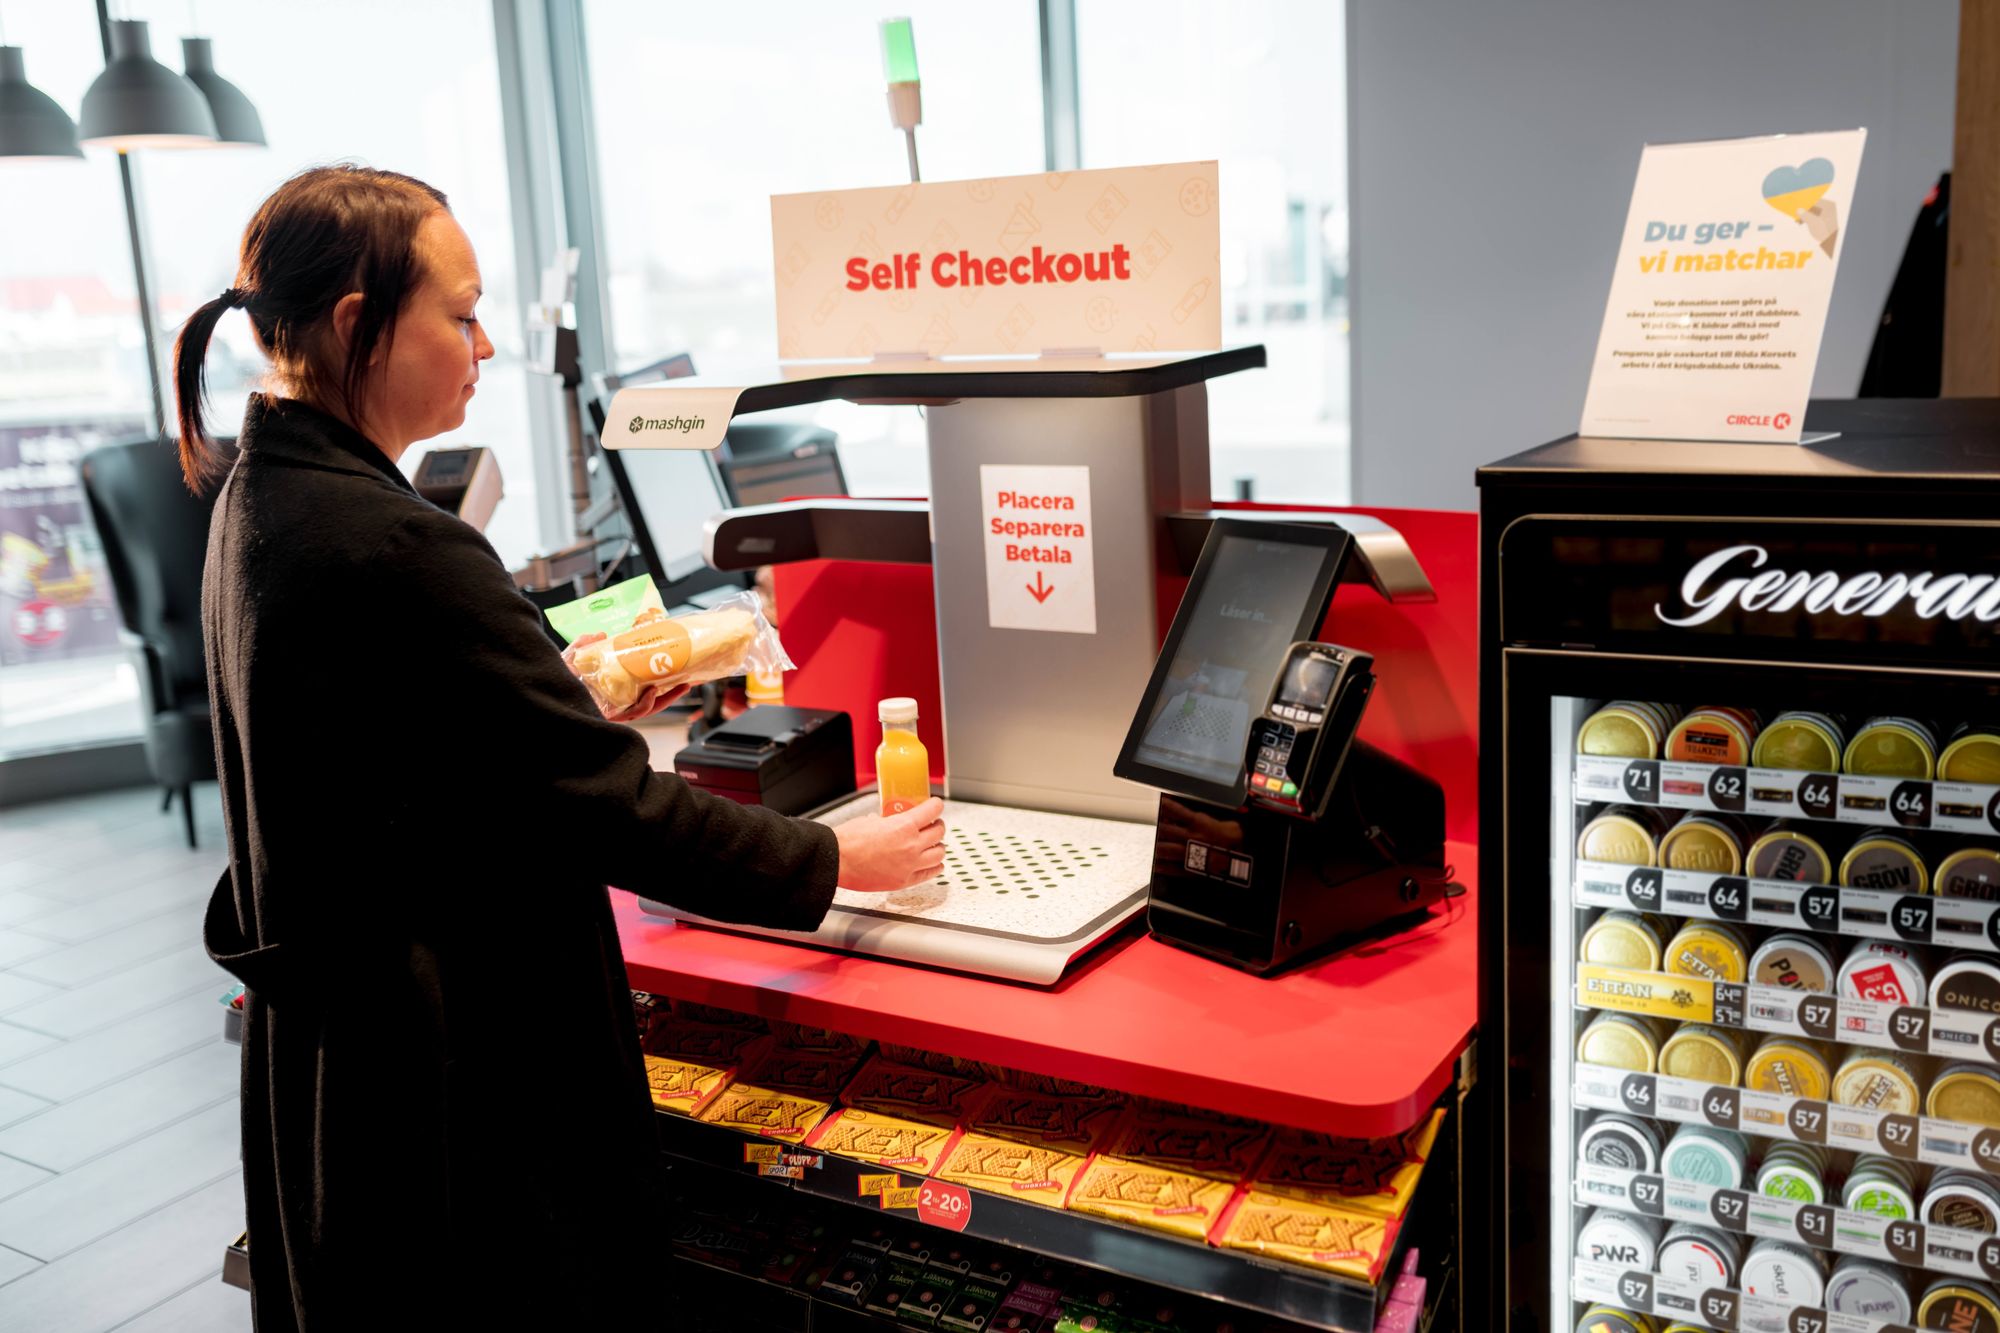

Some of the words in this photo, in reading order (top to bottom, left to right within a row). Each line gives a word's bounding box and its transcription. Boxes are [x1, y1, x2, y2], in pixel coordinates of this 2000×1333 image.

[1644, 221, 1686, 242] Du
[1693, 220, 1749, 245] ger
[845, 253, 921, 292] Self
[931, 244, 1130, 288] Checkout
[1639, 251, 1667, 273] vi
[1673, 247, 1812, 273] matchar
[645, 415, 705, 434] mashgin
[1727, 415, 1770, 426] CIRCLE
[998, 491, 1075, 510] Placera
[991, 517, 1085, 539] Separera
[1006, 544, 1072, 564] Betala
[1629, 769, 1650, 788] 71
[1715, 776, 1740, 796] 62
[1804, 785, 1830, 804] 64
[1896, 792, 1924, 813] 64
[1776, 845, 1806, 879] GRO
[1853, 865, 1911, 889] GROV
[1632, 878, 1656, 897] 64
[1715, 887, 1740, 907] 64
[1808, 897, 1835, 916] 57
[1900, 908, 1928, 929] 57
[1586, 978, 1652, 999] ETTAN
[1944, 992, 2000, 1012] ONICO
[1805, 1005, 1831, 1024] 57
[1897, 1015, 1924, 1035] 57
[1939, 1031, 1972, 1042] ONICO
[647, 1065, 716, 1092] EX
[1626, 1083, 1650, 1103] 64
[708, 1099, 818, 1128] KEX
[1708, 1097, 1733, 1116] 64
[1795, 1109, 1821, 1130] 57
[767, 1127, 799, 1135] CHOKLAD
[1885, 1122, 1912, 1143] 57
[826, 1126, 939, 1159] KEX
[752, 1148, 776, 1160] KEX
[789, 1156, 811, 1167] PLOPP
[887, 1156, 918, 1165] CHOKLAD
[950, 1146, 1069, 1182] KEX
[768, 1165, 790, 1176] SPORT
[865, 1176, 894, 1193] KEX
[1019, 1182, 1053, 1190] CHOKLAD
[1086, 1169, 1215, 1210] KEX
[1635, 1183, 1660, 1203] 57
[886, 1187, 919, 1206] KEX
[922, 1189, 933, 1206] 2
[1718, 1197, 1743, 1217] 57
[1240, 1212, 1377, 1251] KEX
[1803, 1212, 1827, 1234] 51
[1893, 1228, 1917, 1249] 51
[1591, 1244, 1640, 1264] PWR
[1986, 1246, 2000, 1265] 5
[888, 1274, 915, 1286] Läkero
[923, 1272, 955, 1286] Läkerol
[1624, 1279, 1648, 1299] 57
[965, 1284, 997, 1298] Läkerol
[1008, 1296, 1043, 1312] Läkerol
[1708, 1298, 1732, 1318] 57
[1797, 1317, 1822, 1333] 57
